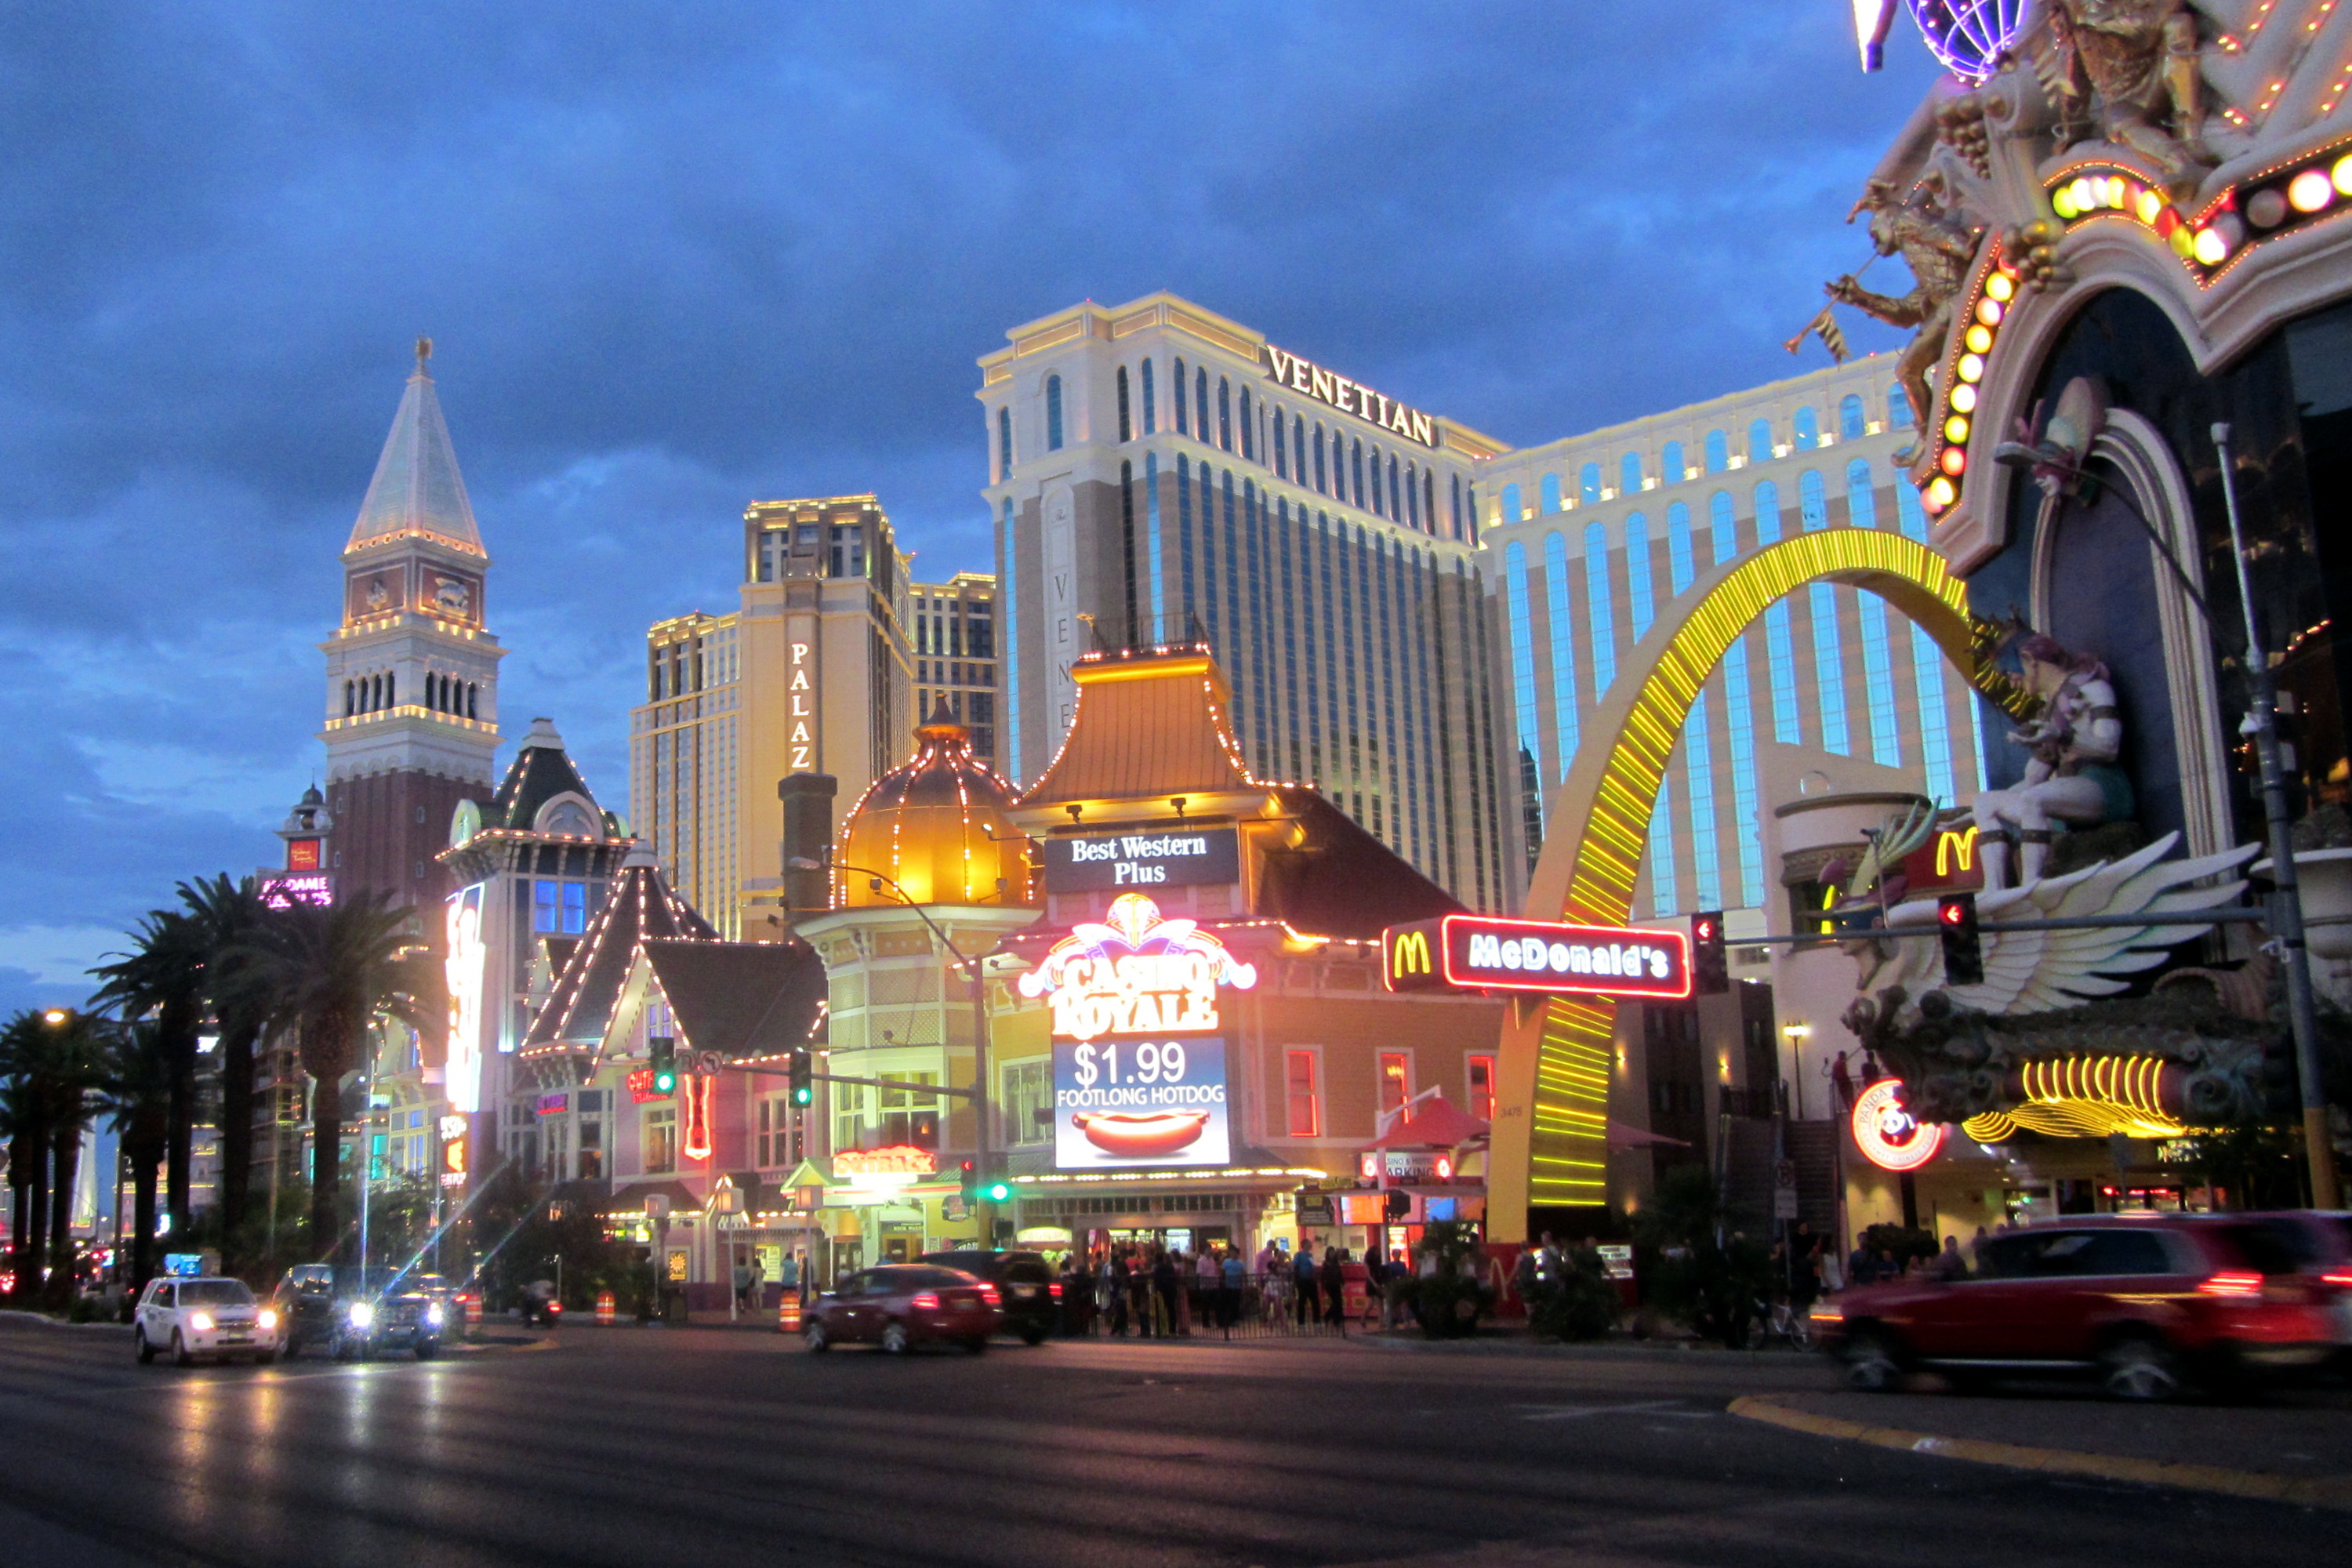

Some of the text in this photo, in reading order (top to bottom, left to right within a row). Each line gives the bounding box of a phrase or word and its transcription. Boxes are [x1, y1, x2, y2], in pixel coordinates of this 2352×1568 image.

[1266, 344, 1433, 447] VENETIAN
[1071, 835, 1207, 862] Best Western
[263, 877, 328, 893] MDAME
[1114, 862, 1166, 884] Plus
[1468, 934, 1669, 978] McDonald's
[1062, 953, 1212, 994] CASINO
[1048, 988, 1218, 1040] ROYALE
[1074, 1041, 1185, 1089] $1.99
[1057, 1085, 1225, 1107] FOOTLONG HOTDOG
[1859, 1088, 1888, 1123] PANDA
[1501, 1107, 1523, 1119] 3475
[834, 1156, 934, 1174] OUTBACK
[1386, 1157, 1404, 1166] SINO
[1387, 1167, 1436, 1176] ARKING
